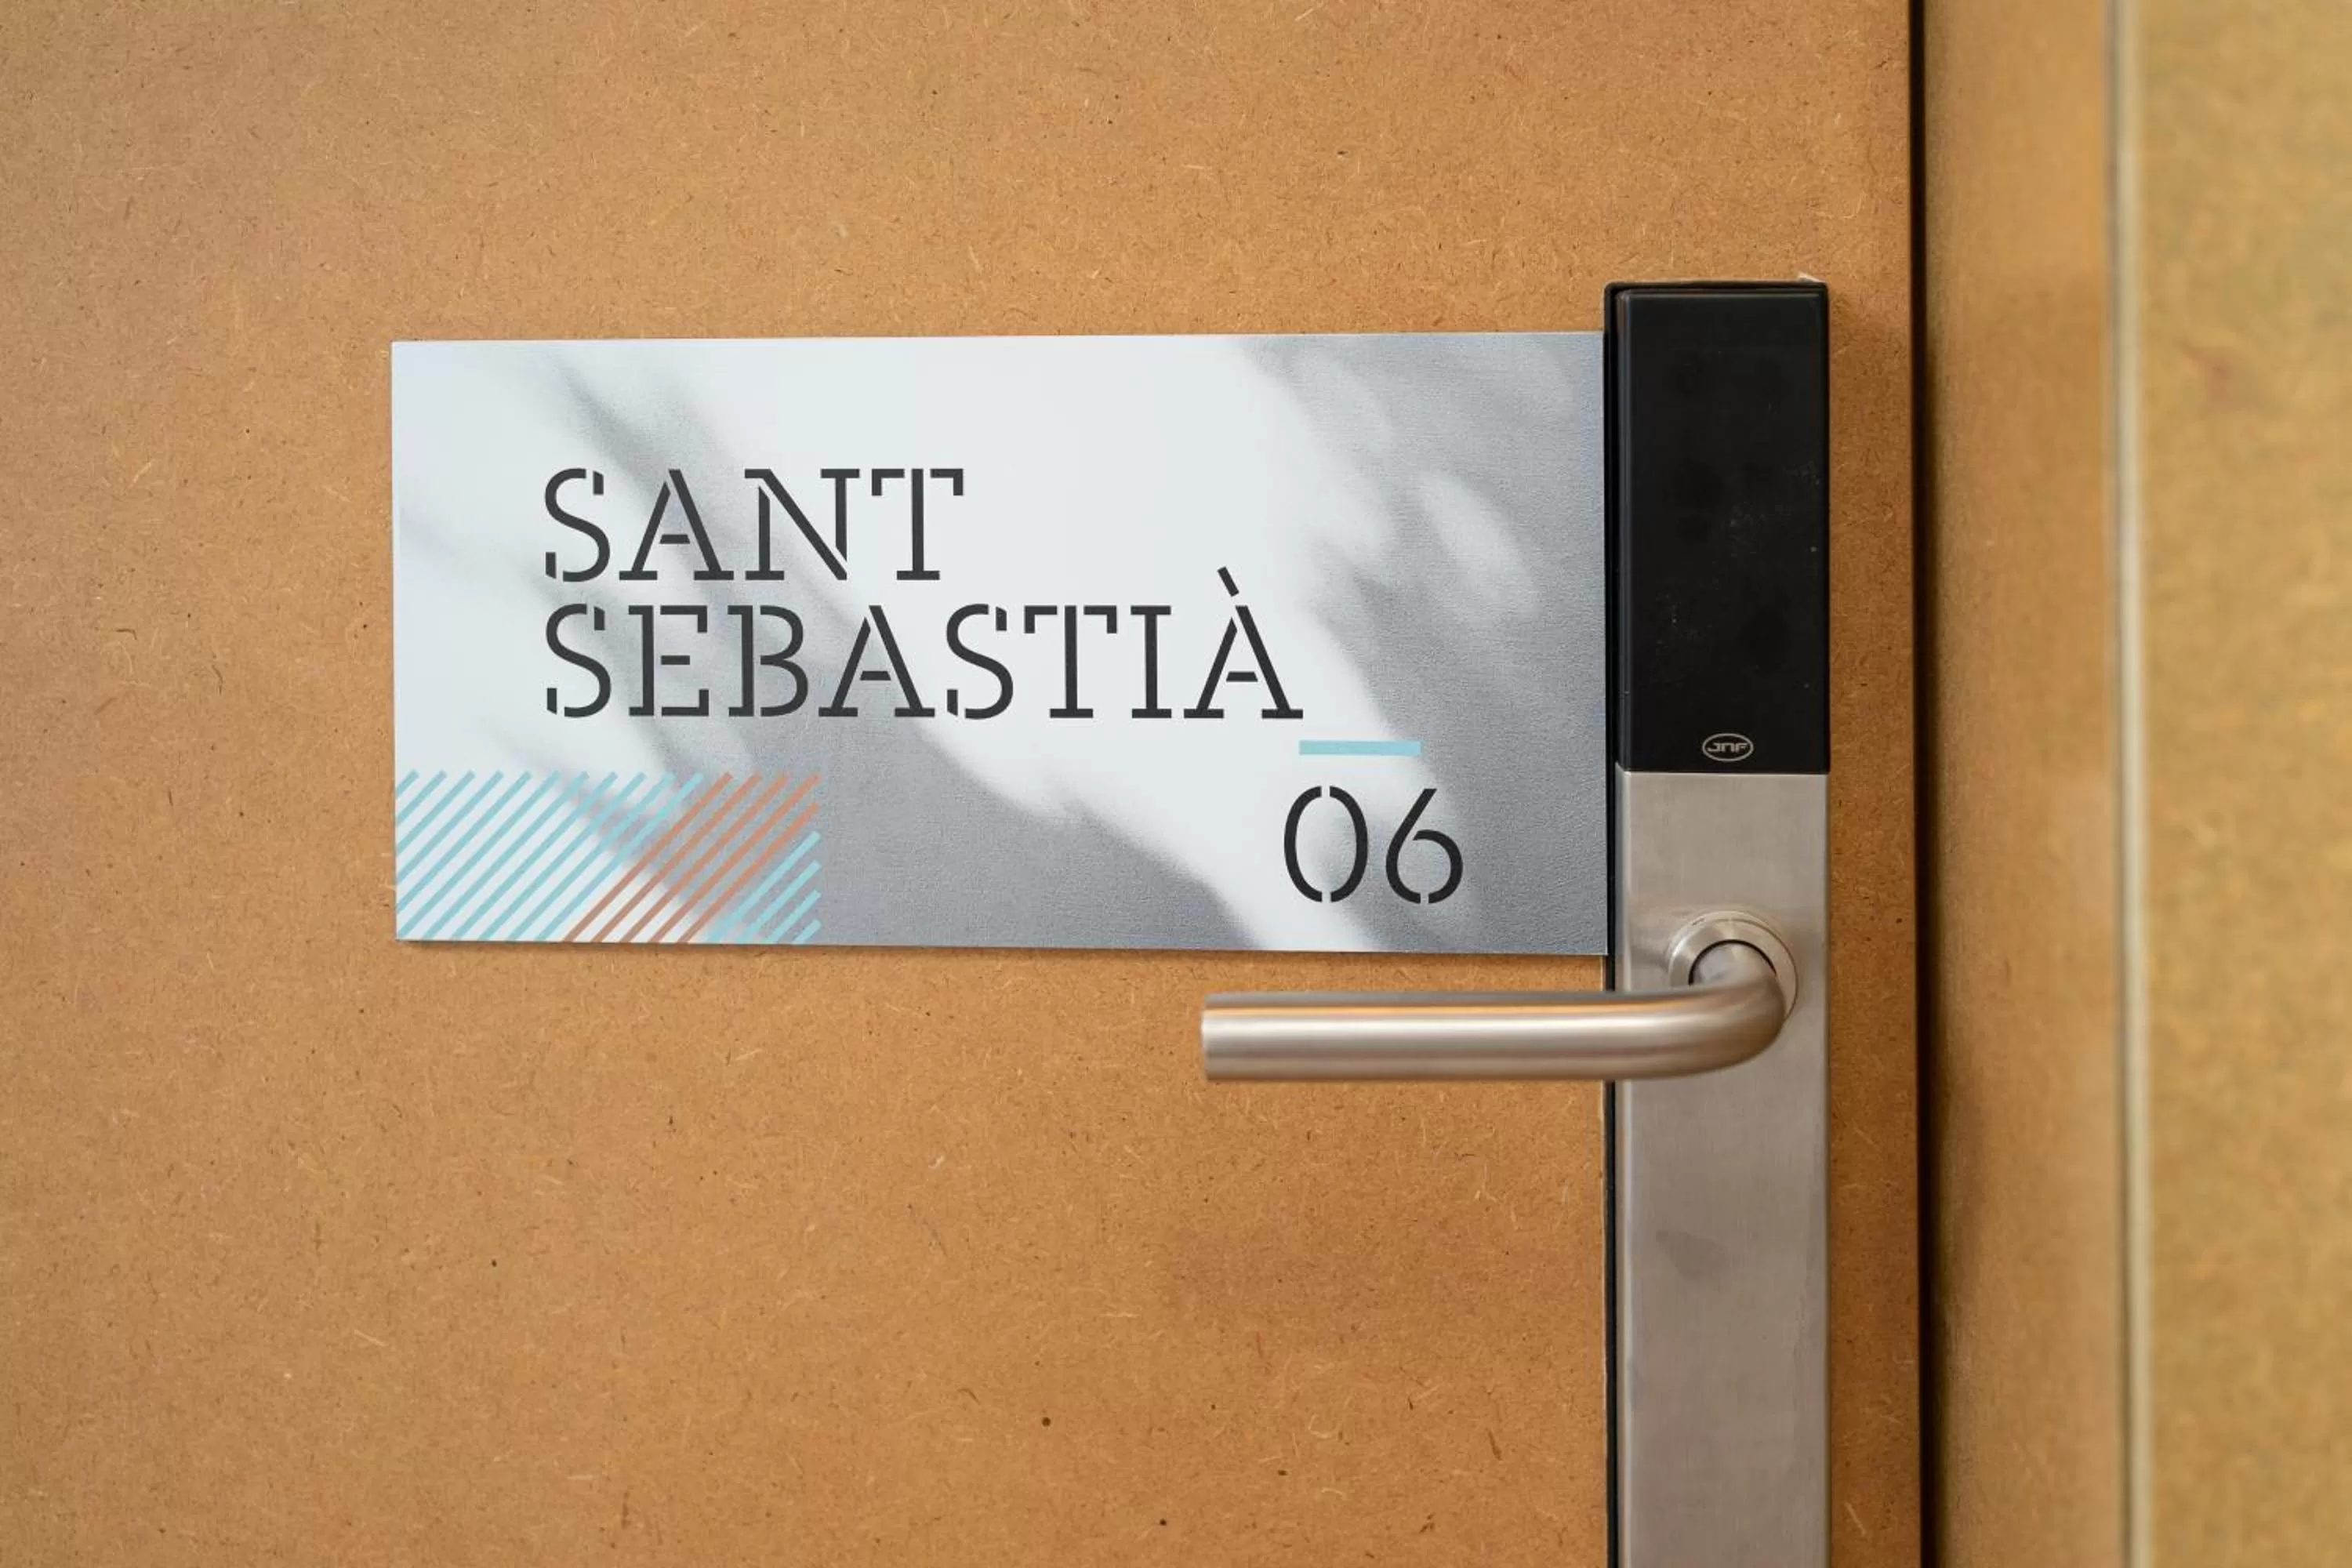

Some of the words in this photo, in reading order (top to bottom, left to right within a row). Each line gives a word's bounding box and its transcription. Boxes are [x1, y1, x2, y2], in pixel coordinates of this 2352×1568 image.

[545, 468, 964, 582] SANT
[546, 566, 1304, 720] SEBASTIÀ
[1283, 786, 1464, 905] 06
